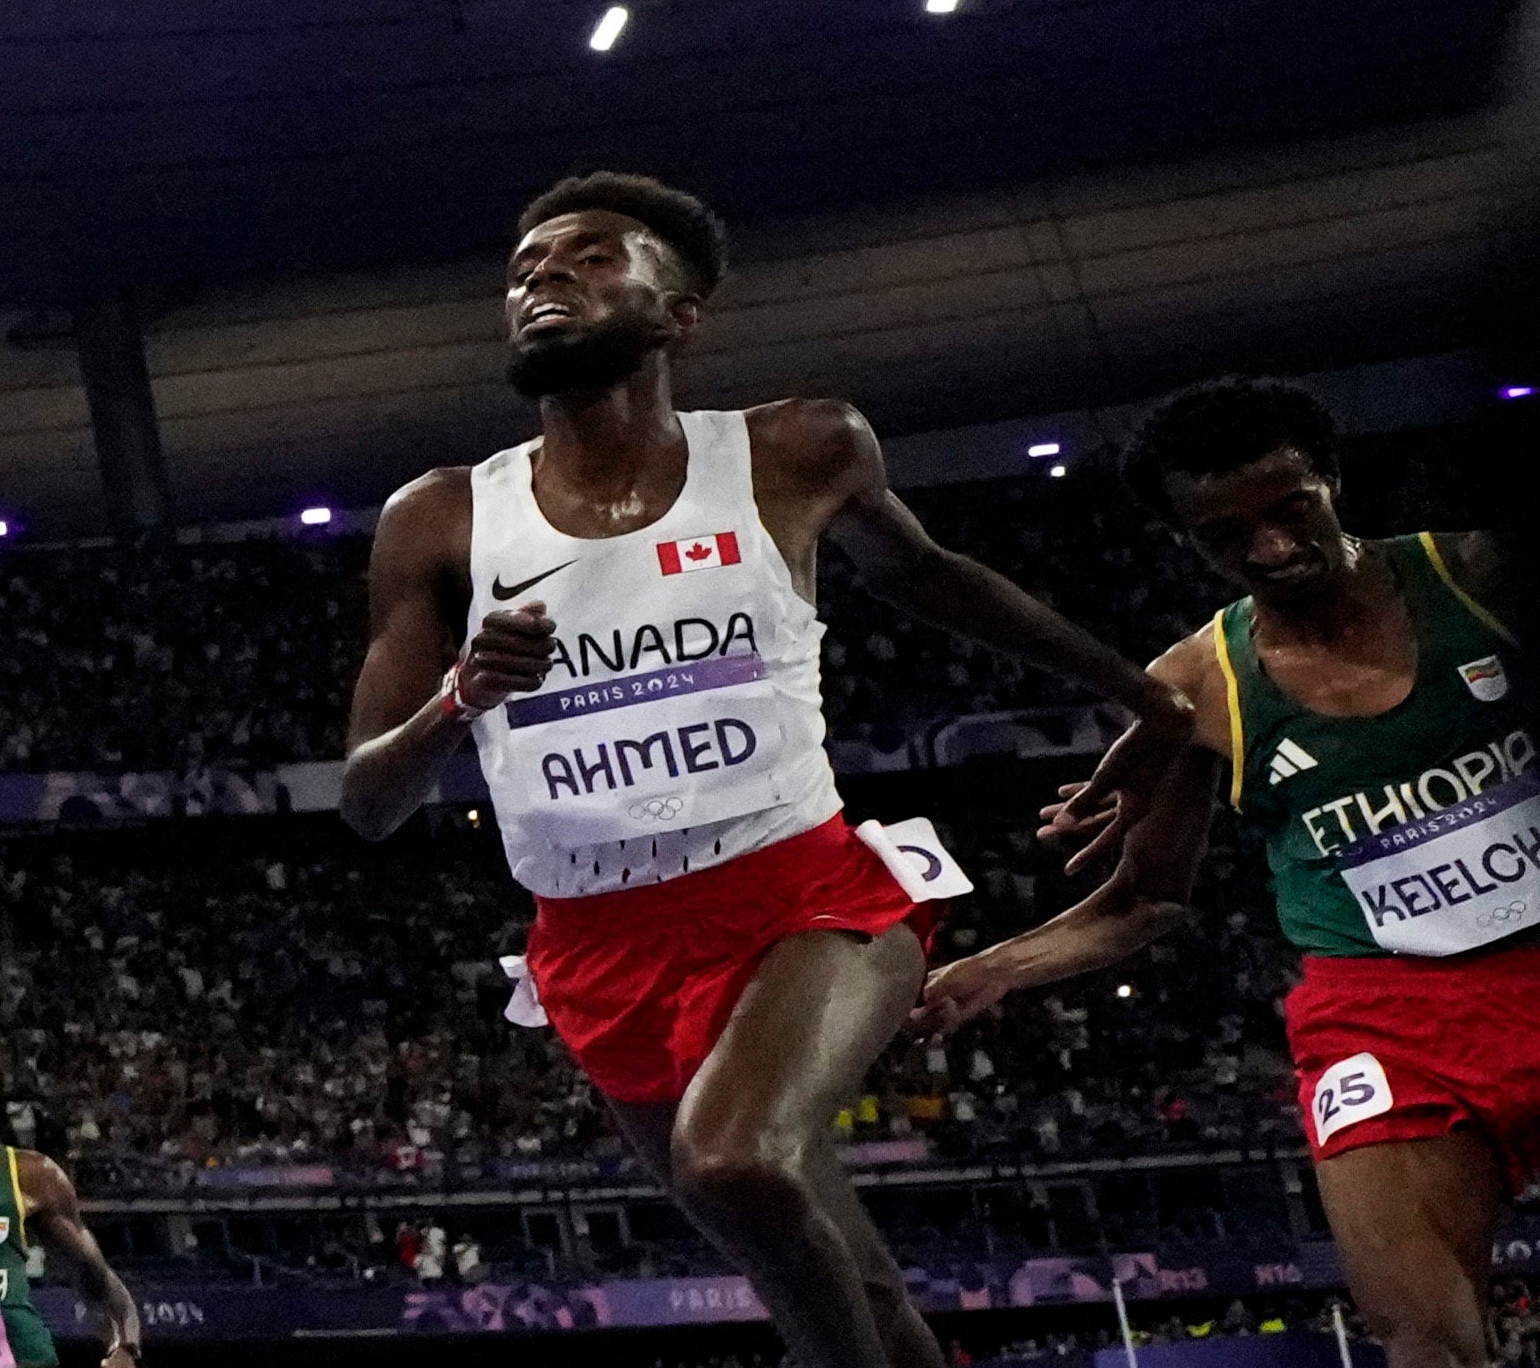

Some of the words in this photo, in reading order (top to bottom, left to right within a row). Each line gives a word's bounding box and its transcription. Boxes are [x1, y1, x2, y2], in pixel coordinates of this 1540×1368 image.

[551, 611, 759, 679] ANADA
[559, 685, 624, 711] PARIS
[631, 673, 695, 696] 2024
[541, 717, 757, 800] AHMED
[1301, 730, 1537, 857] ETHIOPIA
[1380, 819, 1441, 850] PARIS
[1318, 1071, 1375, 1126] 25
